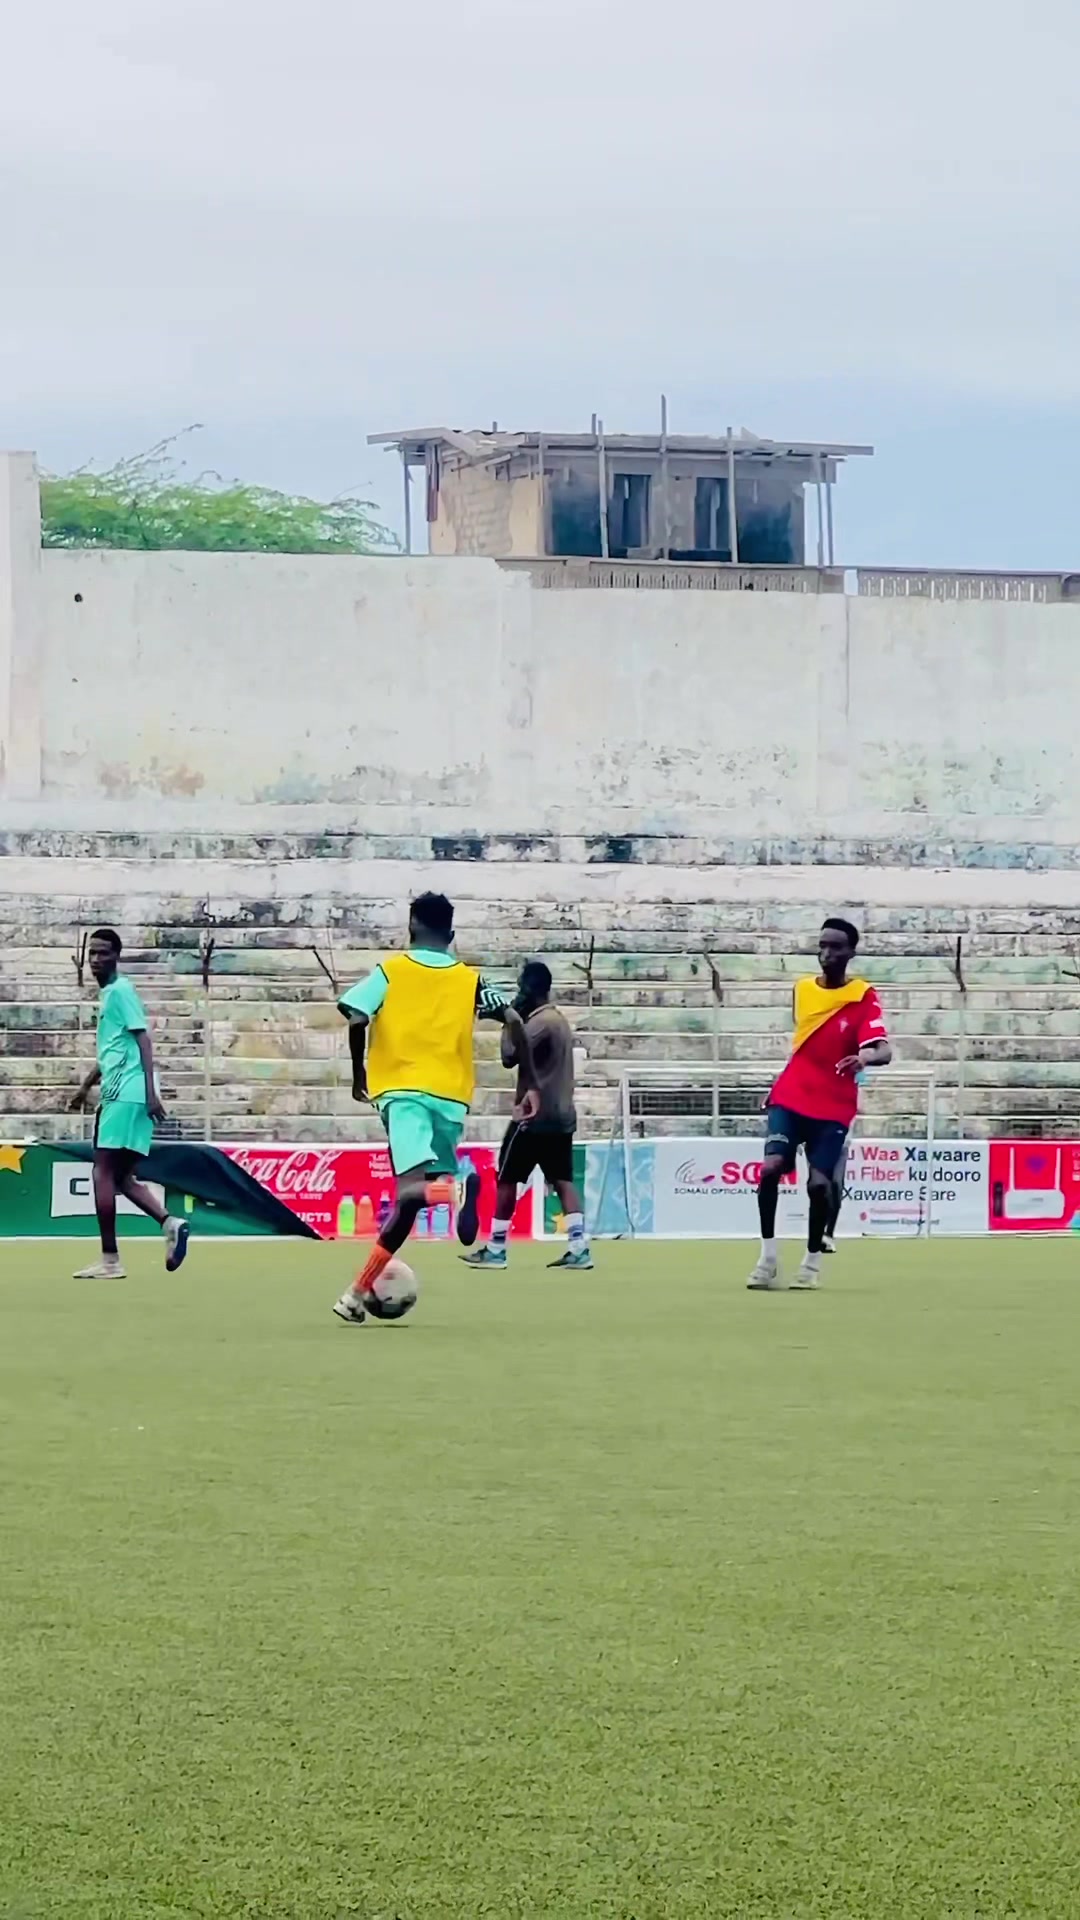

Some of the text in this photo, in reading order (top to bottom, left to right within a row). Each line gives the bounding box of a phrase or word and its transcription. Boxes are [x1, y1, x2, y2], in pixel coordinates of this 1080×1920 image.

[861, 1147, 899, 1161] Waa
[861, 1167, 904, 1182] Fiber
[909, 1167, 927, 1182] ku
[933, 1167, 981, 1182] dooro
[841, 1187, 914, 1201] Xawaare
